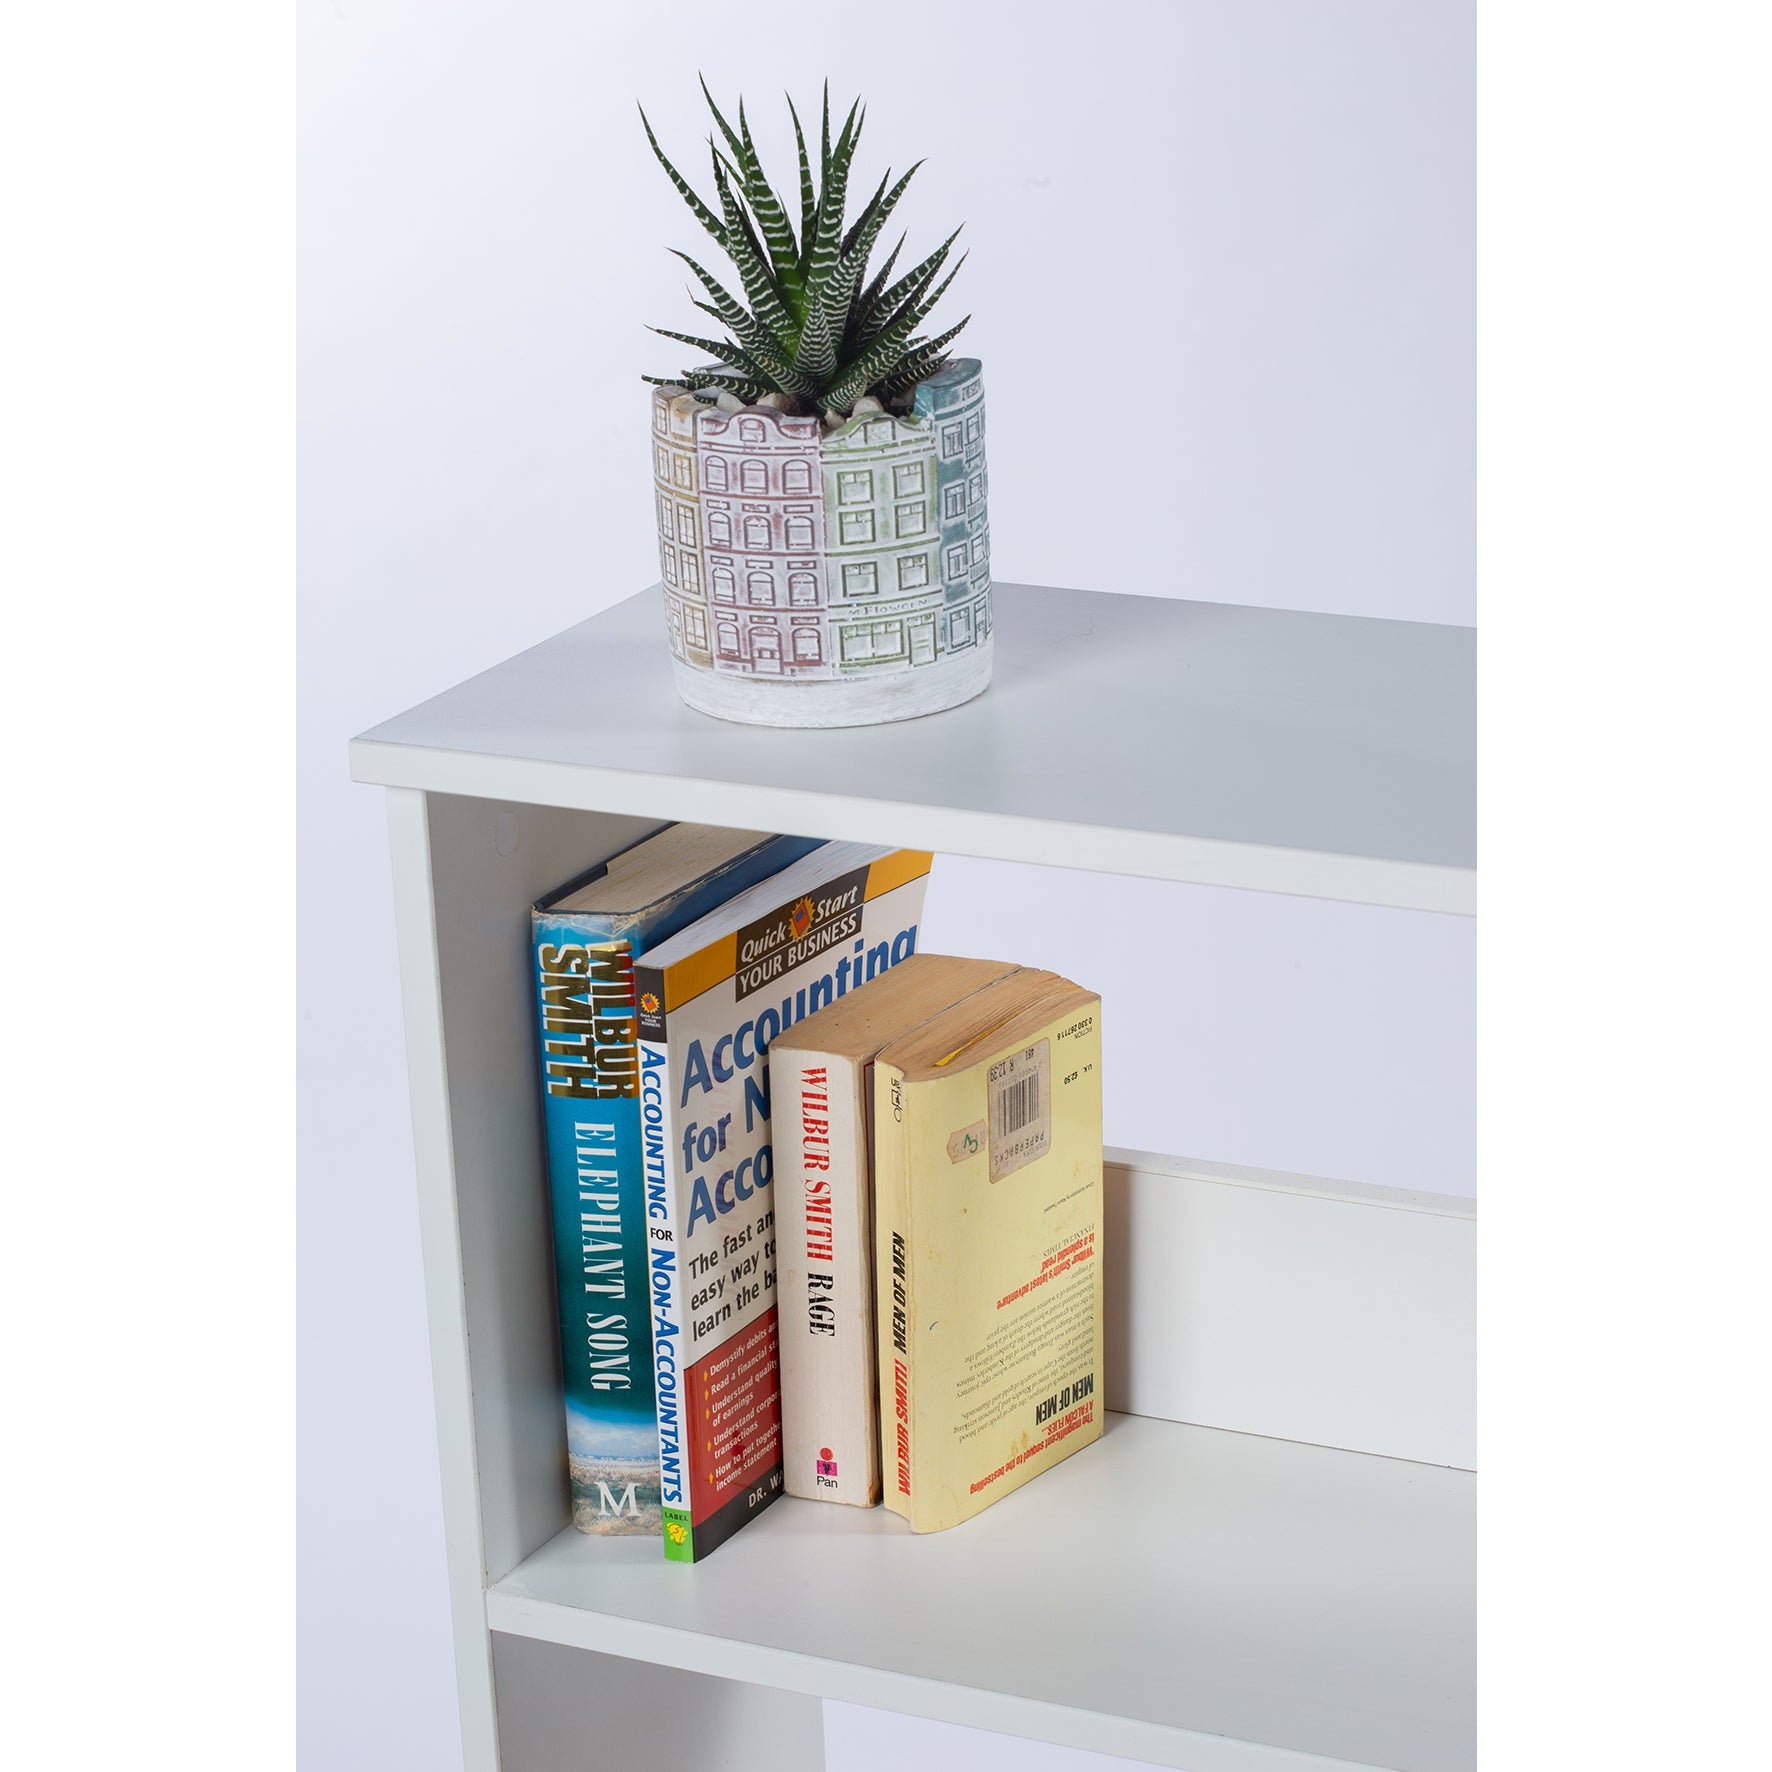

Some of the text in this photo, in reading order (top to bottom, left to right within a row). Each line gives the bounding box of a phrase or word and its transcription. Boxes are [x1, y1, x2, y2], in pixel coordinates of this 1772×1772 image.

[741, 885, 858, 964] Quick Start
[739, 913, 857, 995] YOUR BUSINESS
[538, 943, 598, 1099] SMITH
[585, 938, 640, 1099] WILBUR
[682, 1112, 731, 1173] for
[994, 1130, 1043, 1166] PAPERBACKS
[800, 1066, 836, 1337] WILBUR SMITH RAGE
[574, 1121, 632, 1391] ELEPHANT SONG
[688, 1249, 718, 1280] The
[722, 1224, 752, 1259] fast
[1057, 1237, 1082, 1262] splendid
[1083, 1235, 1087, 1245] a
[1088, 1232, 1094, 1244] is
[640, 1045, 683, 1503] ACCOUNTING FOR NON-ACCOUNTANTS
[691, 1276, 726, 1311] easy
[731, 1251, 760, 1285] way
[996, 1283, 1028, 1311] adventure
[1030, 1271, 1047, 1291] latest
[692, 1303, 731, 1342] learn
[736, 1280, 760, 1311] the
[710, 1319, 777, 1377] Demystify debits an
[711, 1374, 729, 1395] Read
[731, 1371, 735, 1380] a
[737, 1345, 766, 1376] financial
[892, 1231, 911, 1496] WILBUR SMITH MEN OF MEN
[712, 1356, 777, 1414] Understand quality
[712, 1389, 753, 1428] of earnings
[1035, 1372, 1093, 1425] MEN OF MEN
[1089, 1399, 1093, 1411] A
[713, 1389, 779, 1446] Understand corpor
[714, 1418, 757, 1460] transactions
[1064, 1402, 1088, 1425] FALCON
[715, 1458, 731, 1479] How
[733, 1452, 740, 1464] to
[742, 1441, 754, 1459] put
[716, 1436, 776, 1492] income statement
[970, 1411, 1092, 1496] The magnificent sequel to the bestselling
[593, 1481, 642, 1517] M
[748, 1489, 767, 1508] DR.
[816, 1476, 838, 1488] Pan
[664, 1512, 689, 1522] LABEL
